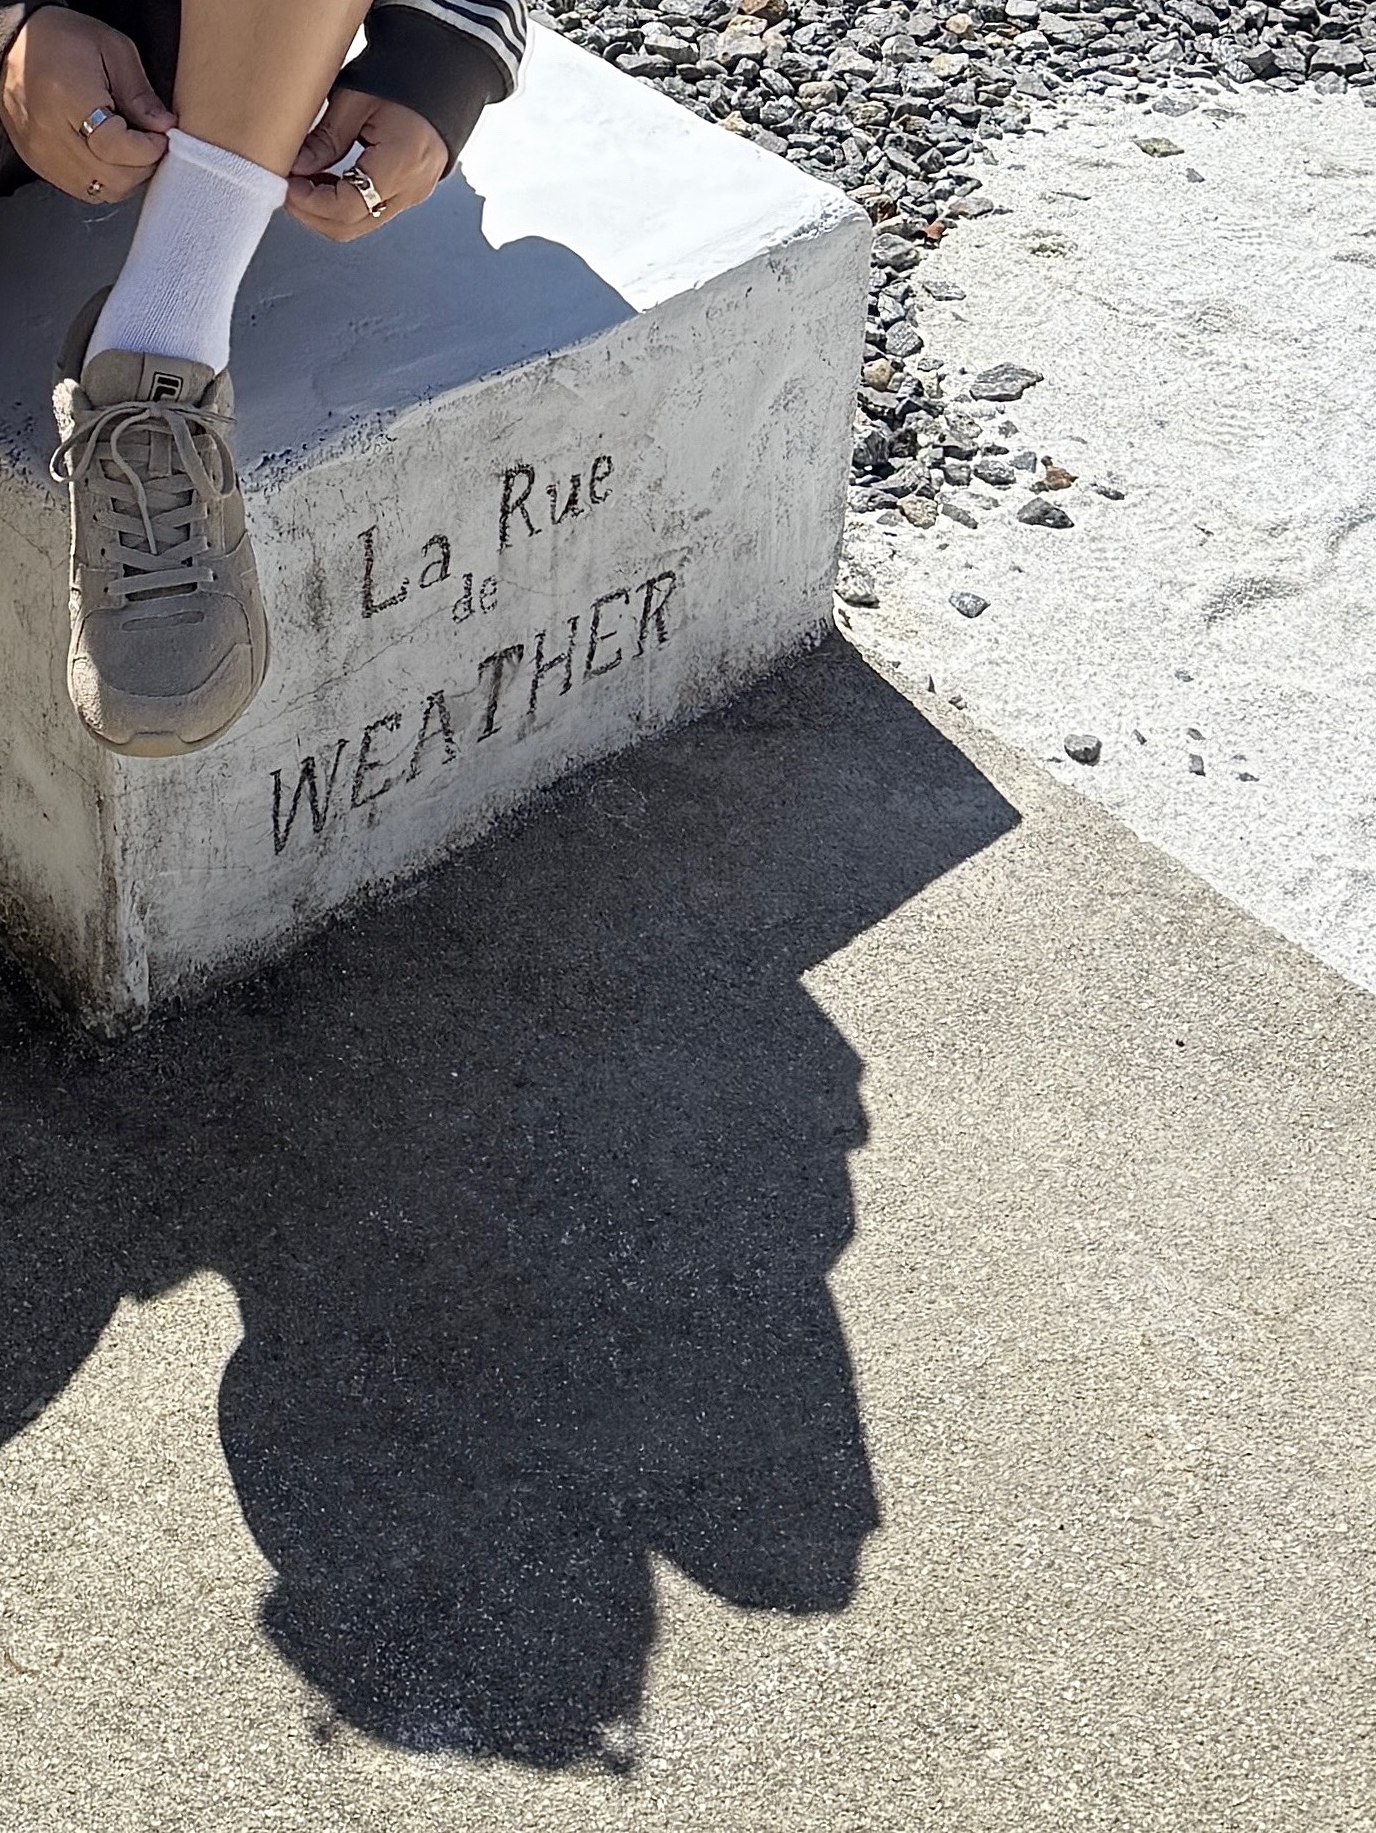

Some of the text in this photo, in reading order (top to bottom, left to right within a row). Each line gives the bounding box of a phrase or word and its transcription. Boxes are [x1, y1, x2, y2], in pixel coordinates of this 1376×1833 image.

[358, 454, 614, 619] La Rue
[451, 572, 499, 624] de
[269, 569, 677, 856] WEATHER
